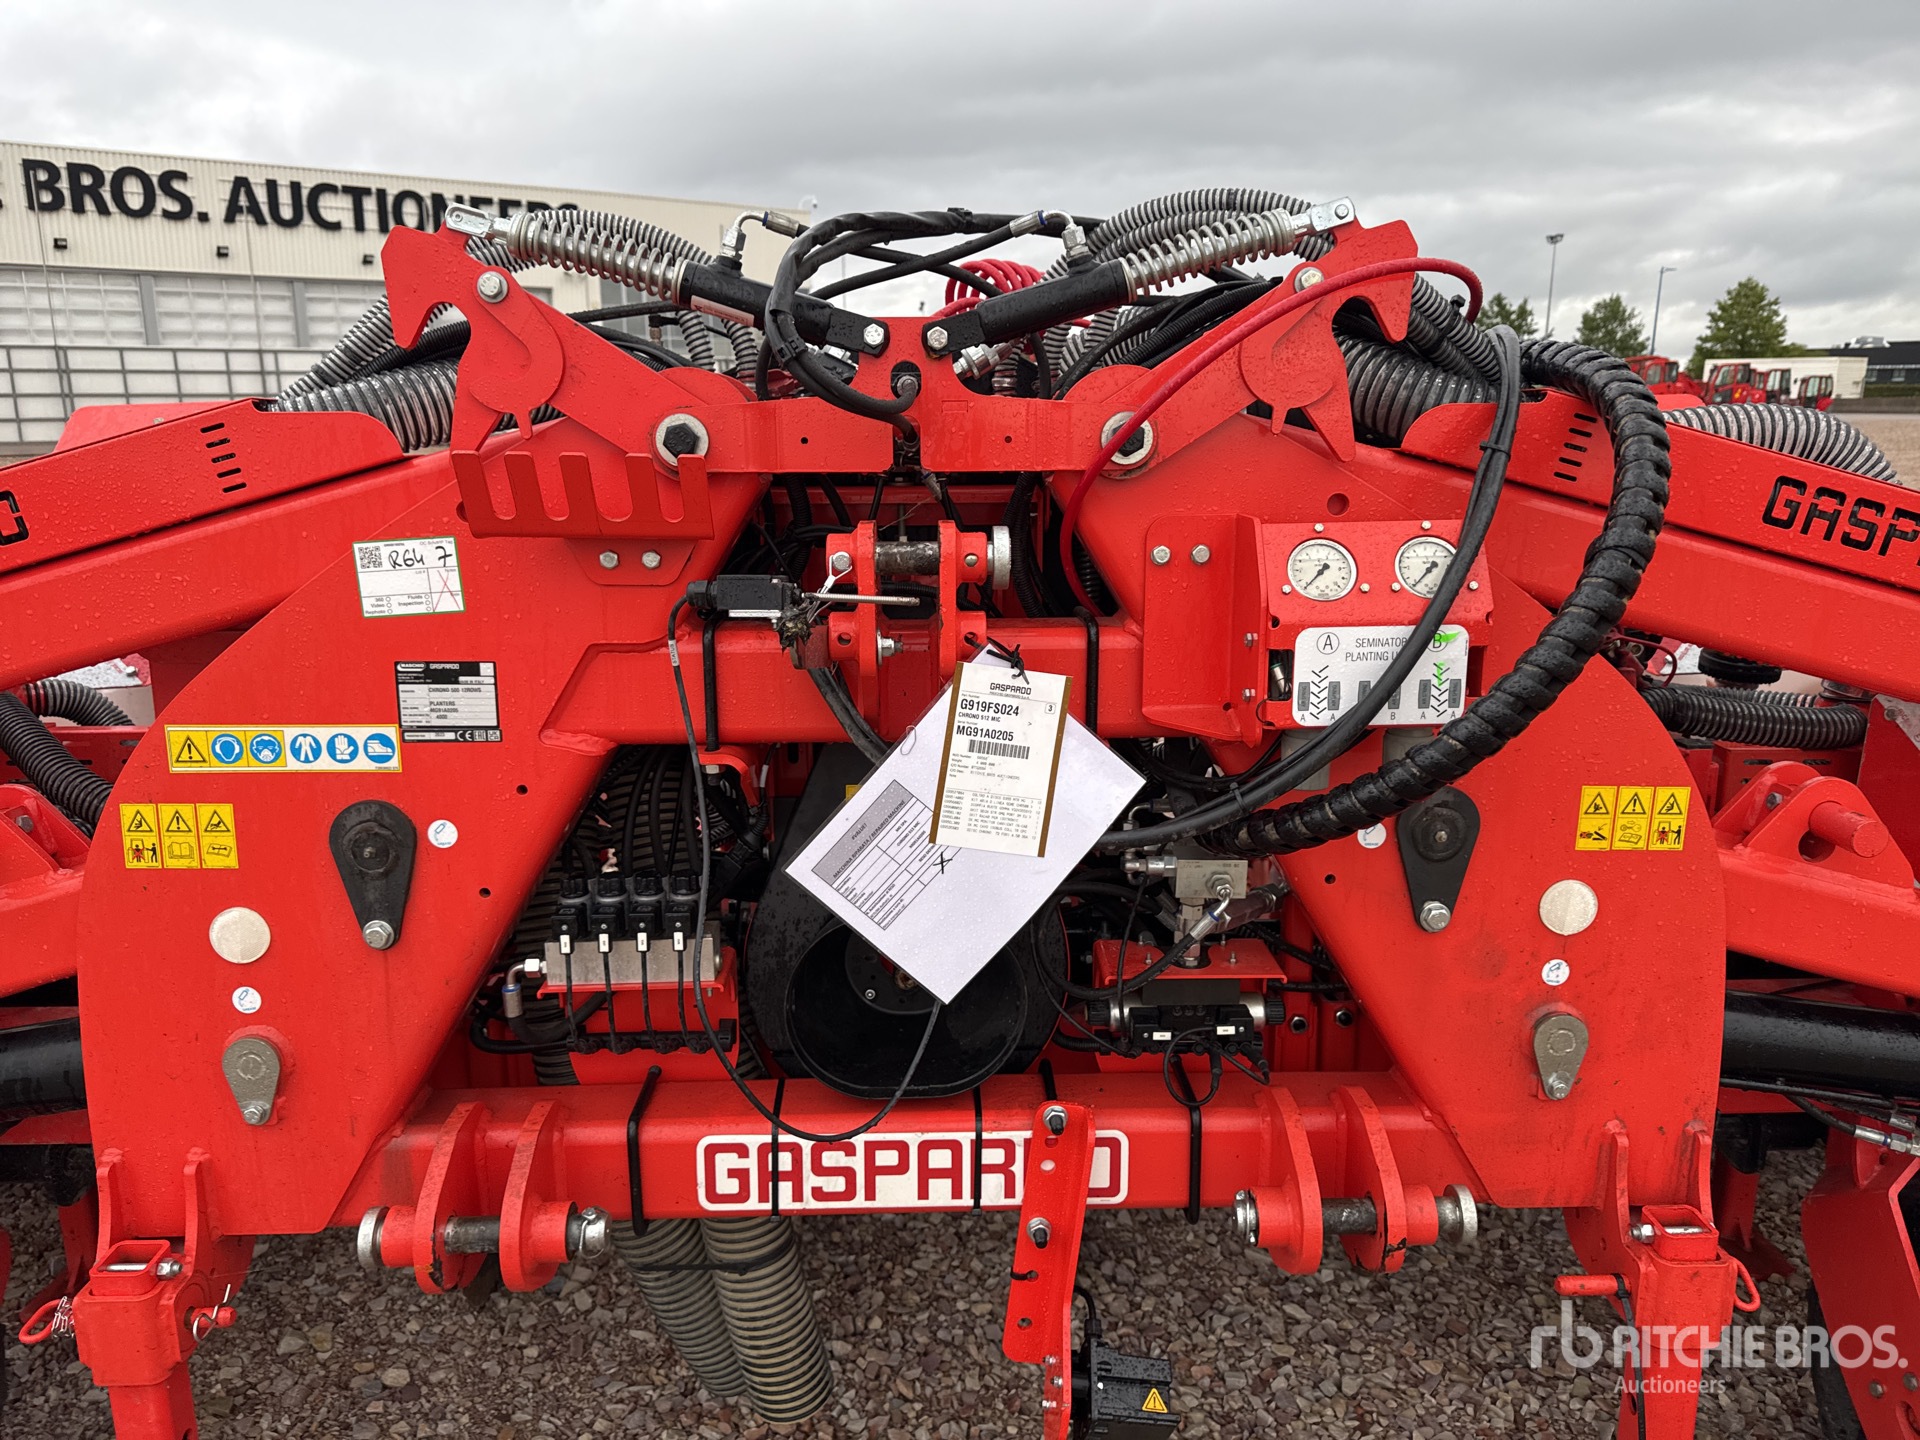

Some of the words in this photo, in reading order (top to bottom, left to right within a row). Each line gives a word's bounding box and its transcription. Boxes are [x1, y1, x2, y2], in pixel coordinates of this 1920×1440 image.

[22, 158, 209, 223] BROS.
[1762, 475, 1920, 567] GASP
[388, 548, 425, 569] R64
[435, 546, 452, 567] 7
[1322, 635, 1334, 650] A
[1433, 634, 1442, 649] B
[1345, 652, 1388, 662] PLANTING
[990, 682, 1031, 695] GASPARDO
[960, 698, 1019, 716] G919FS024
[1048, 704, 1053, 712] 3
[956, 725, 1014, 741] MG91A0205
[887, 799, 905, 819] MACHINE
[704, 1138, 1122, 1204] GASPARO
